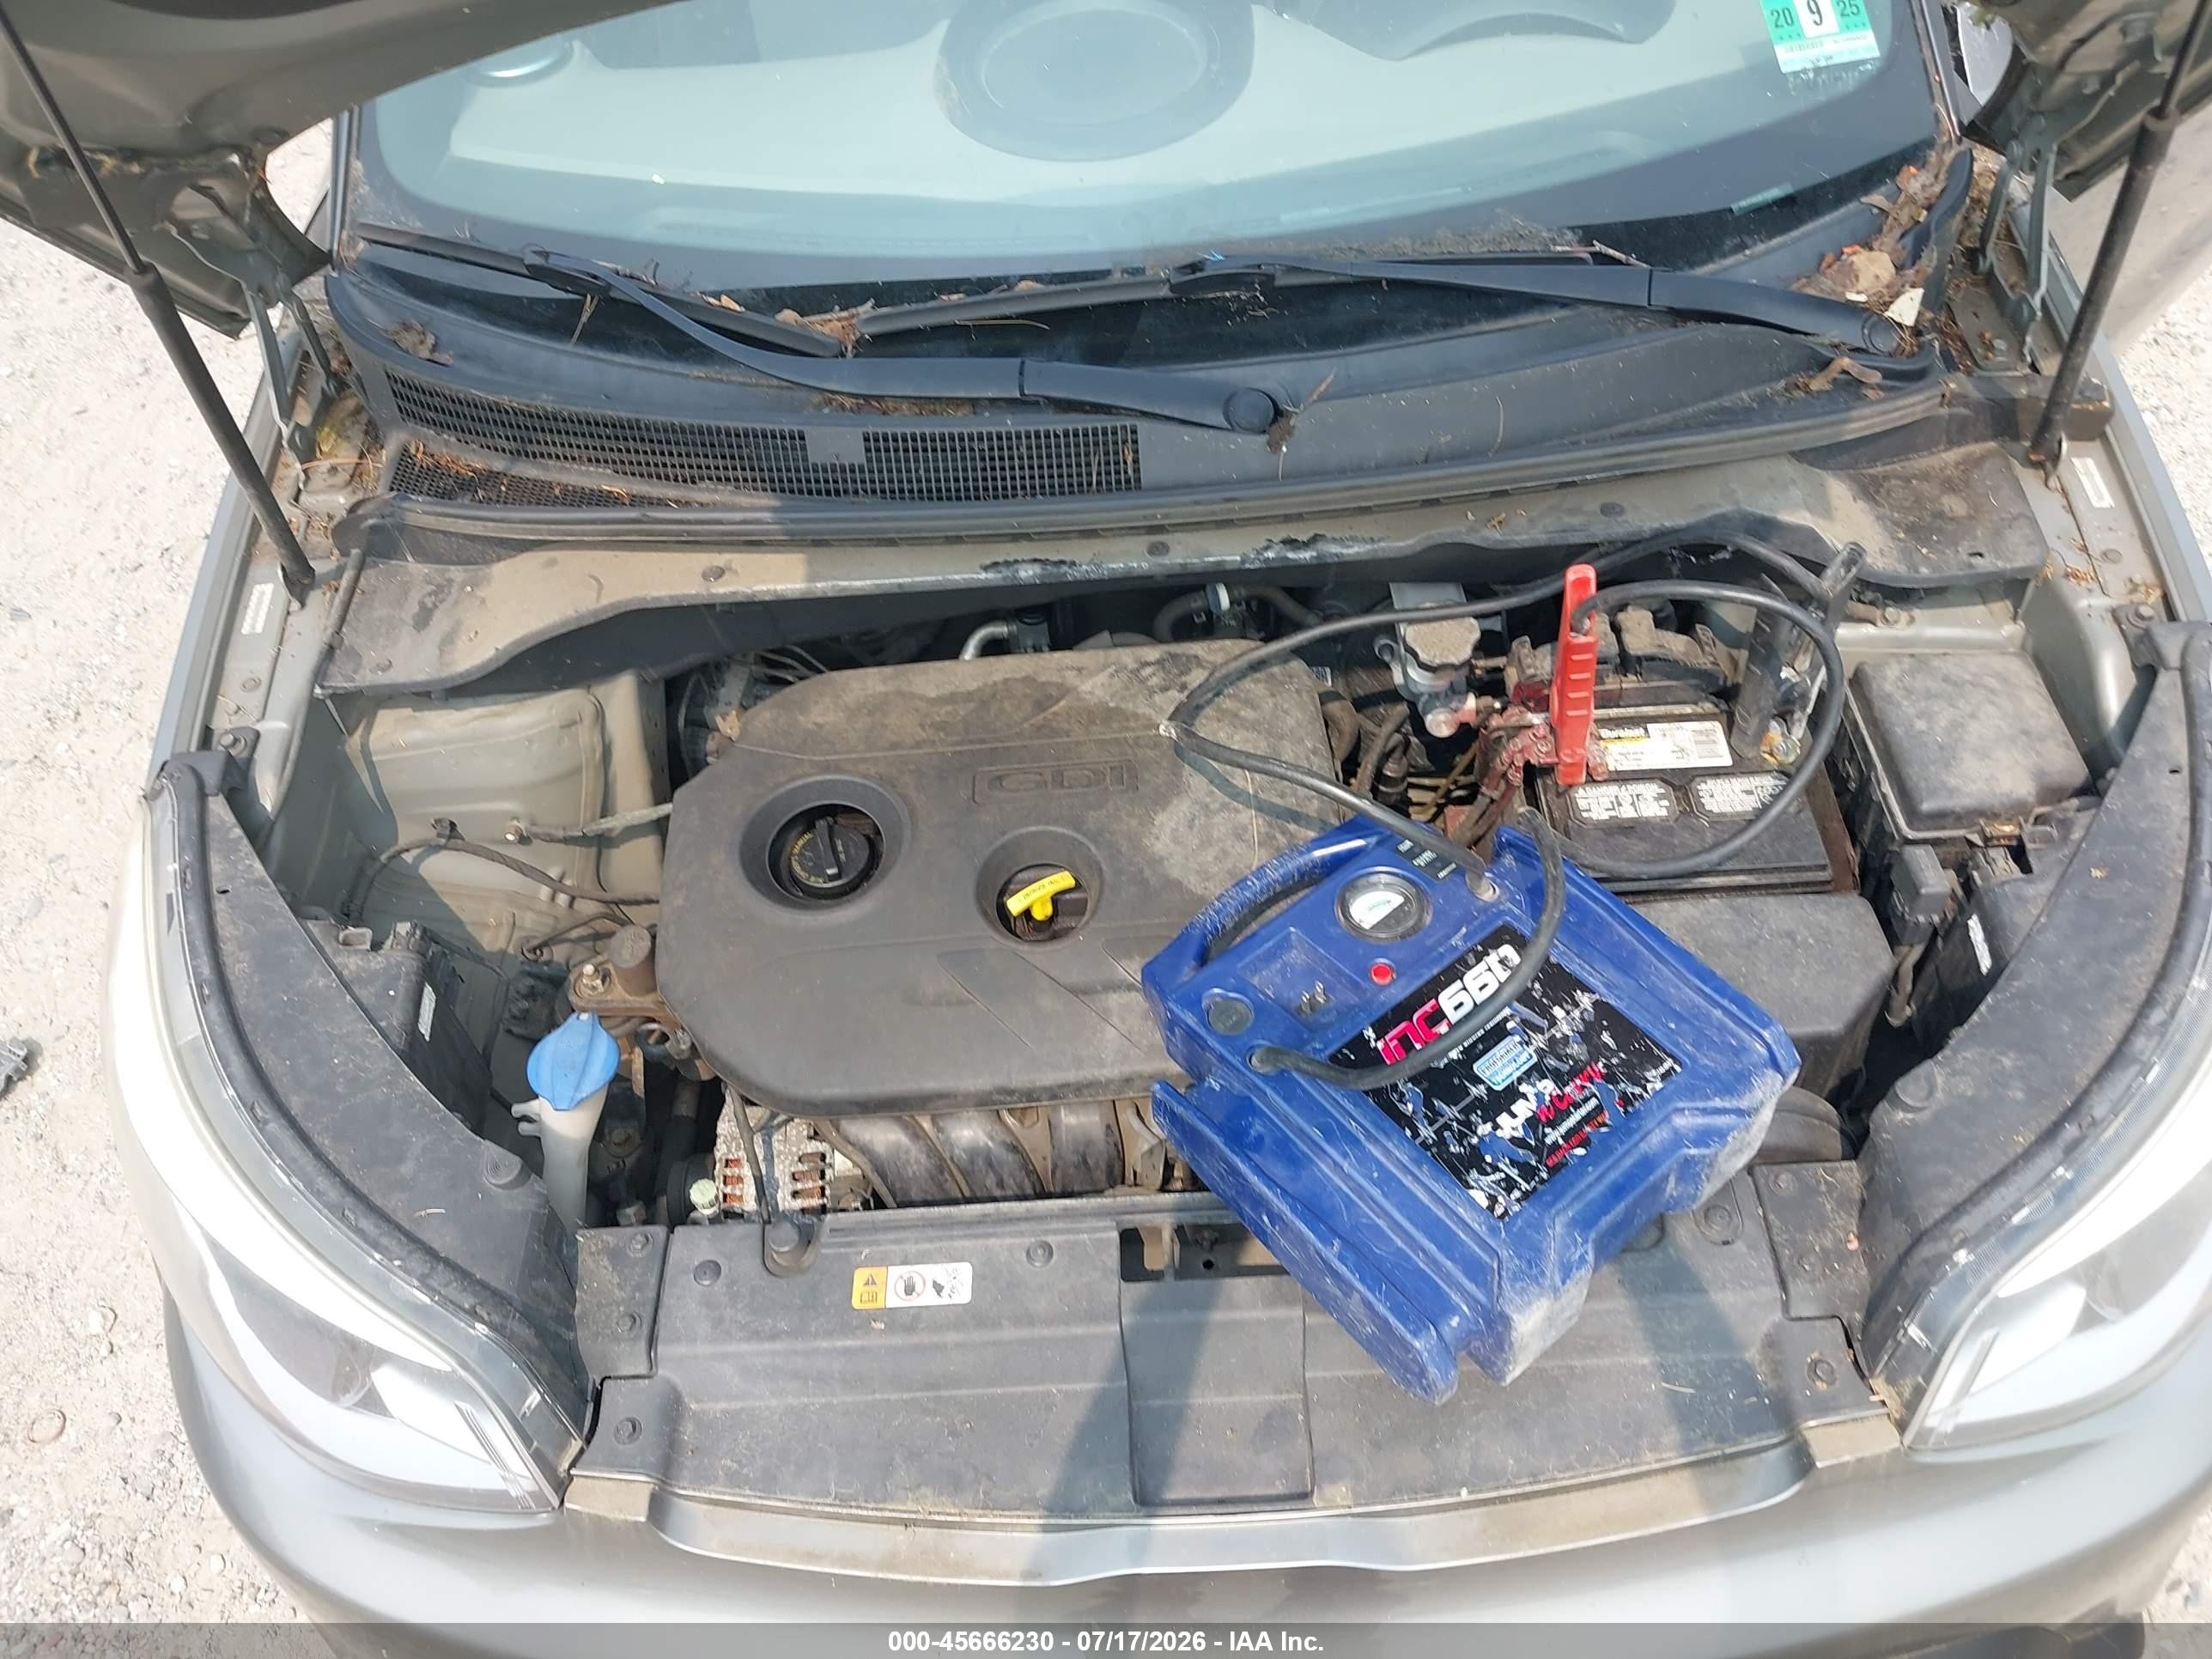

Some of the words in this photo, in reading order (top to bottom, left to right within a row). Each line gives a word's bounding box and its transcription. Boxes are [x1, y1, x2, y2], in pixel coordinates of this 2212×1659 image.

[1771, 8, 1794, 27] 20
[1807, 0, 1823, 26] 9
[1837, 0, 1860, 17] 25
[988, 764, 1126, 792] GDI
